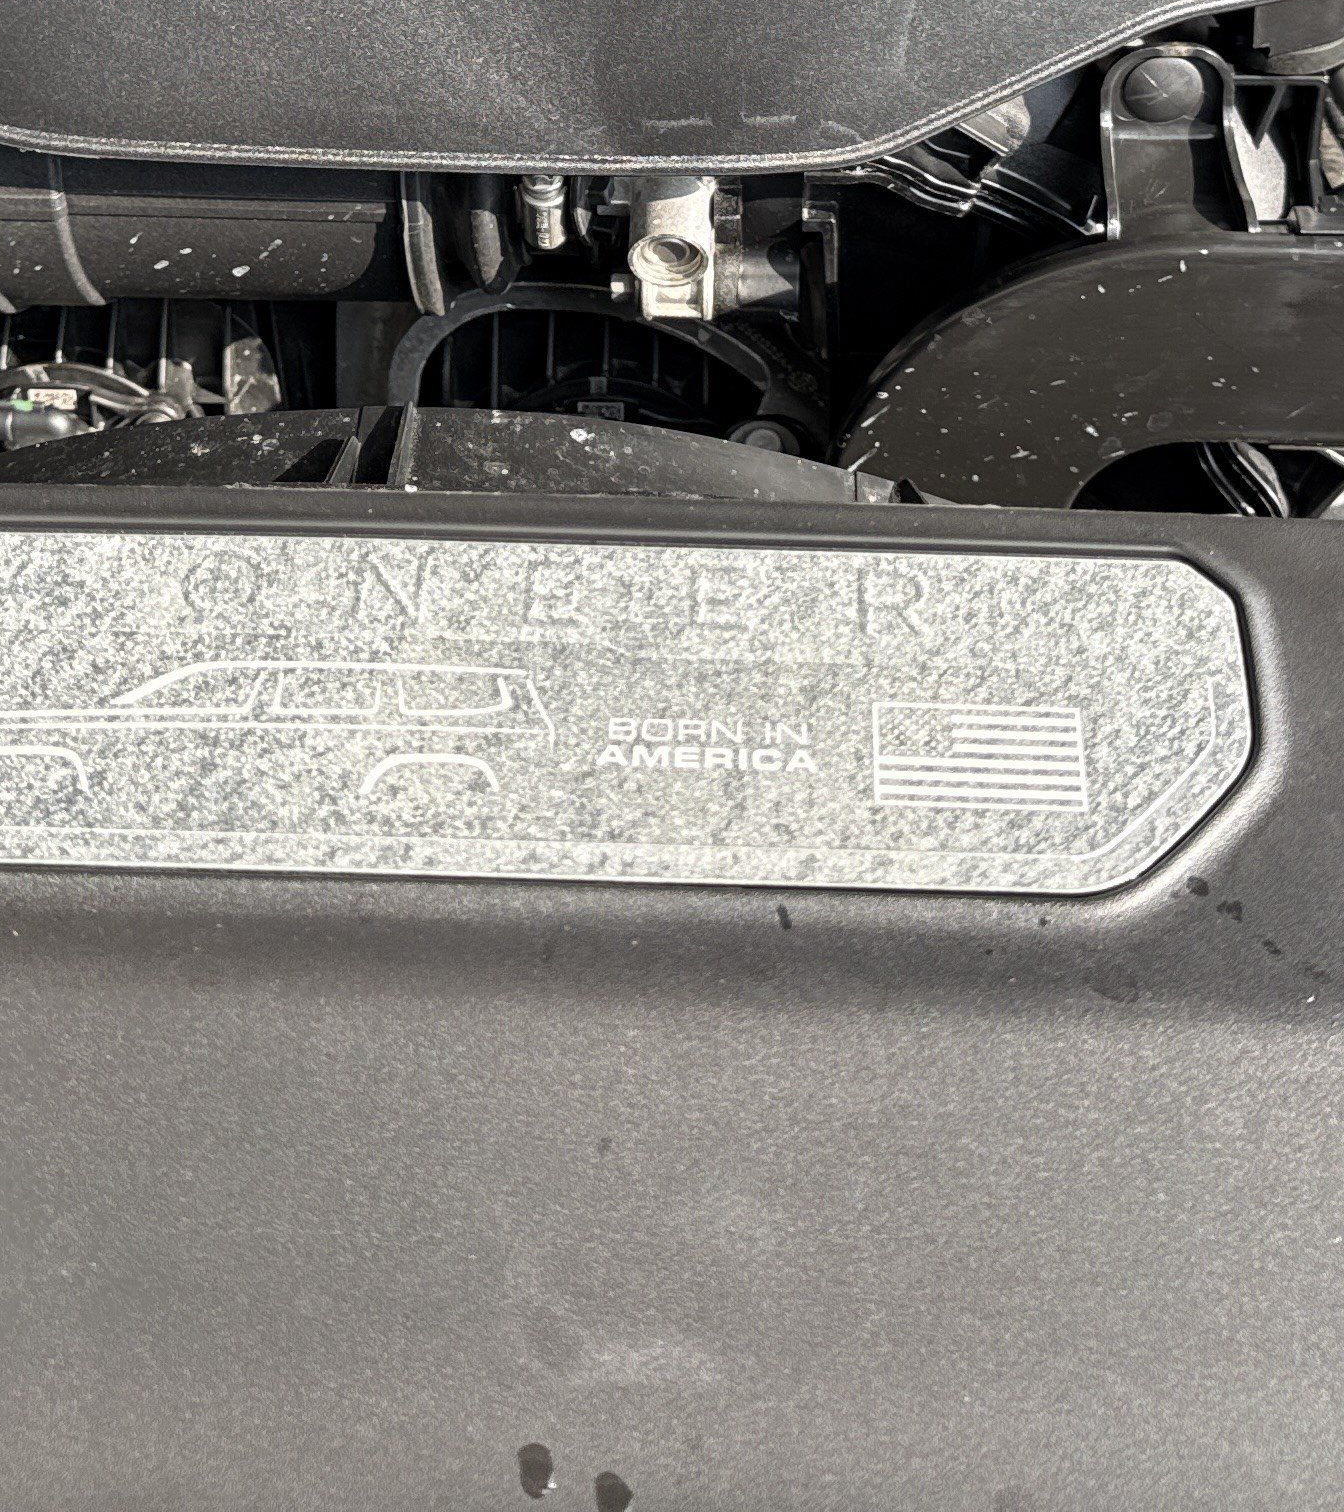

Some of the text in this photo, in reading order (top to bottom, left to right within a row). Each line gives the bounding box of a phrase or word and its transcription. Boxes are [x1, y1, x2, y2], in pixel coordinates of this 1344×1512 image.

[608, 717, 812, 745] BORN IN
[595, 744, 819, 773] AMERICA
